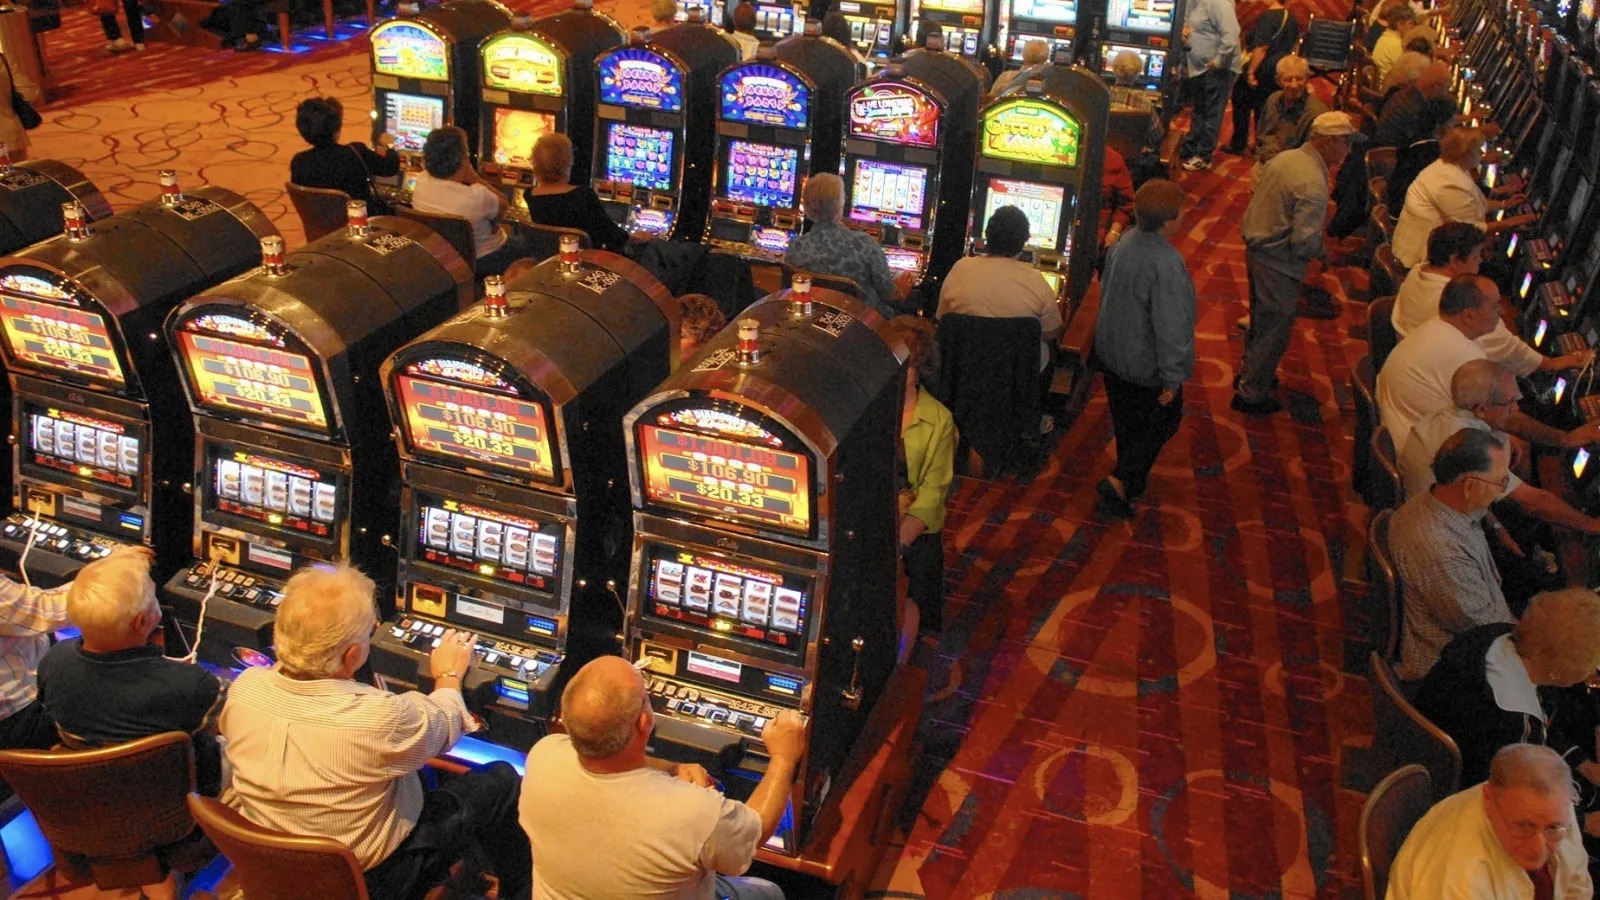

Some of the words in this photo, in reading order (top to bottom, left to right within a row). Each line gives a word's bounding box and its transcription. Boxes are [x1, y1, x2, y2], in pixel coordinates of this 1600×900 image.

[223, 363, 290, 388] $106.90
[235, 385, 292, 408] $20.33
[442, 408, 515, 435] $106.90
[453, 431, 514, 455] $20.33
[687, 460, 769, 487] $106.90
[696, 482, 764, 508] $20.33
